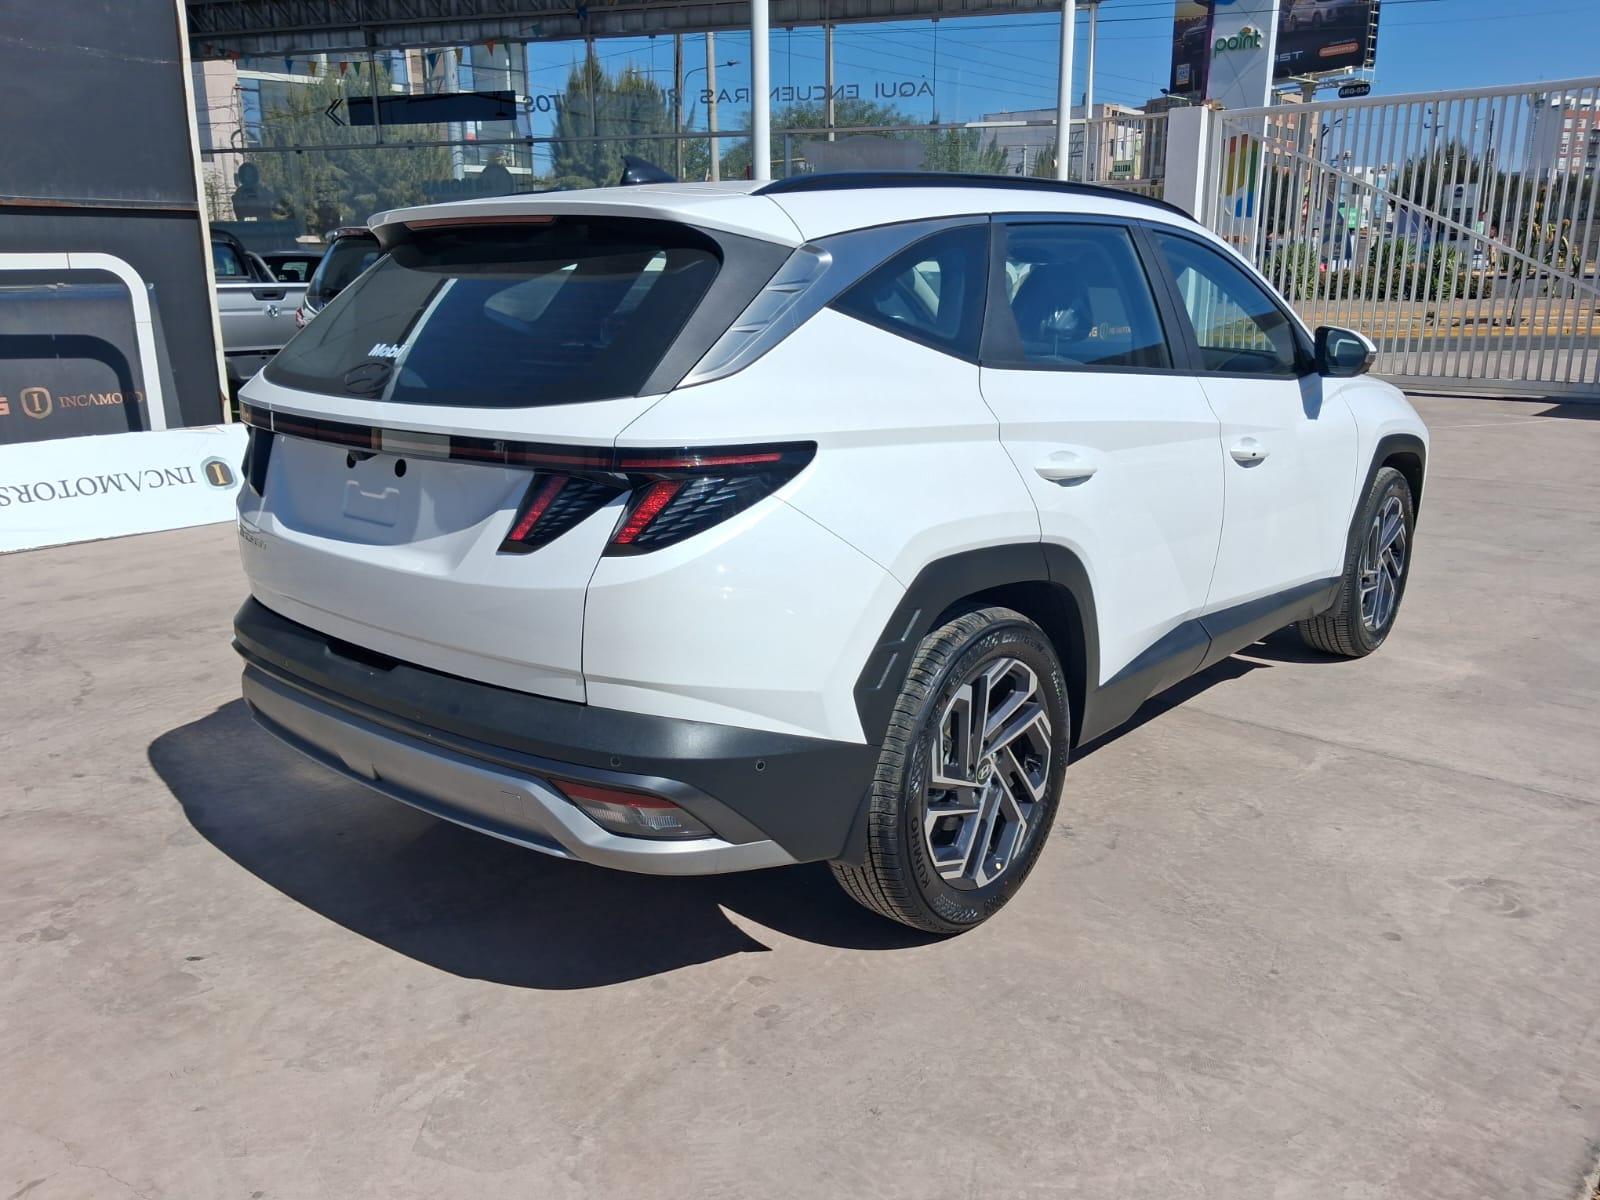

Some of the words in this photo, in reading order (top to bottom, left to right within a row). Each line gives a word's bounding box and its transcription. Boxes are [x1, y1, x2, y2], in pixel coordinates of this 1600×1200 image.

[1214, 27, 1262, 58] point
[0, 466, 197, 507] INCAMOTORS
[911, 816, 932, 889] KUMHO
